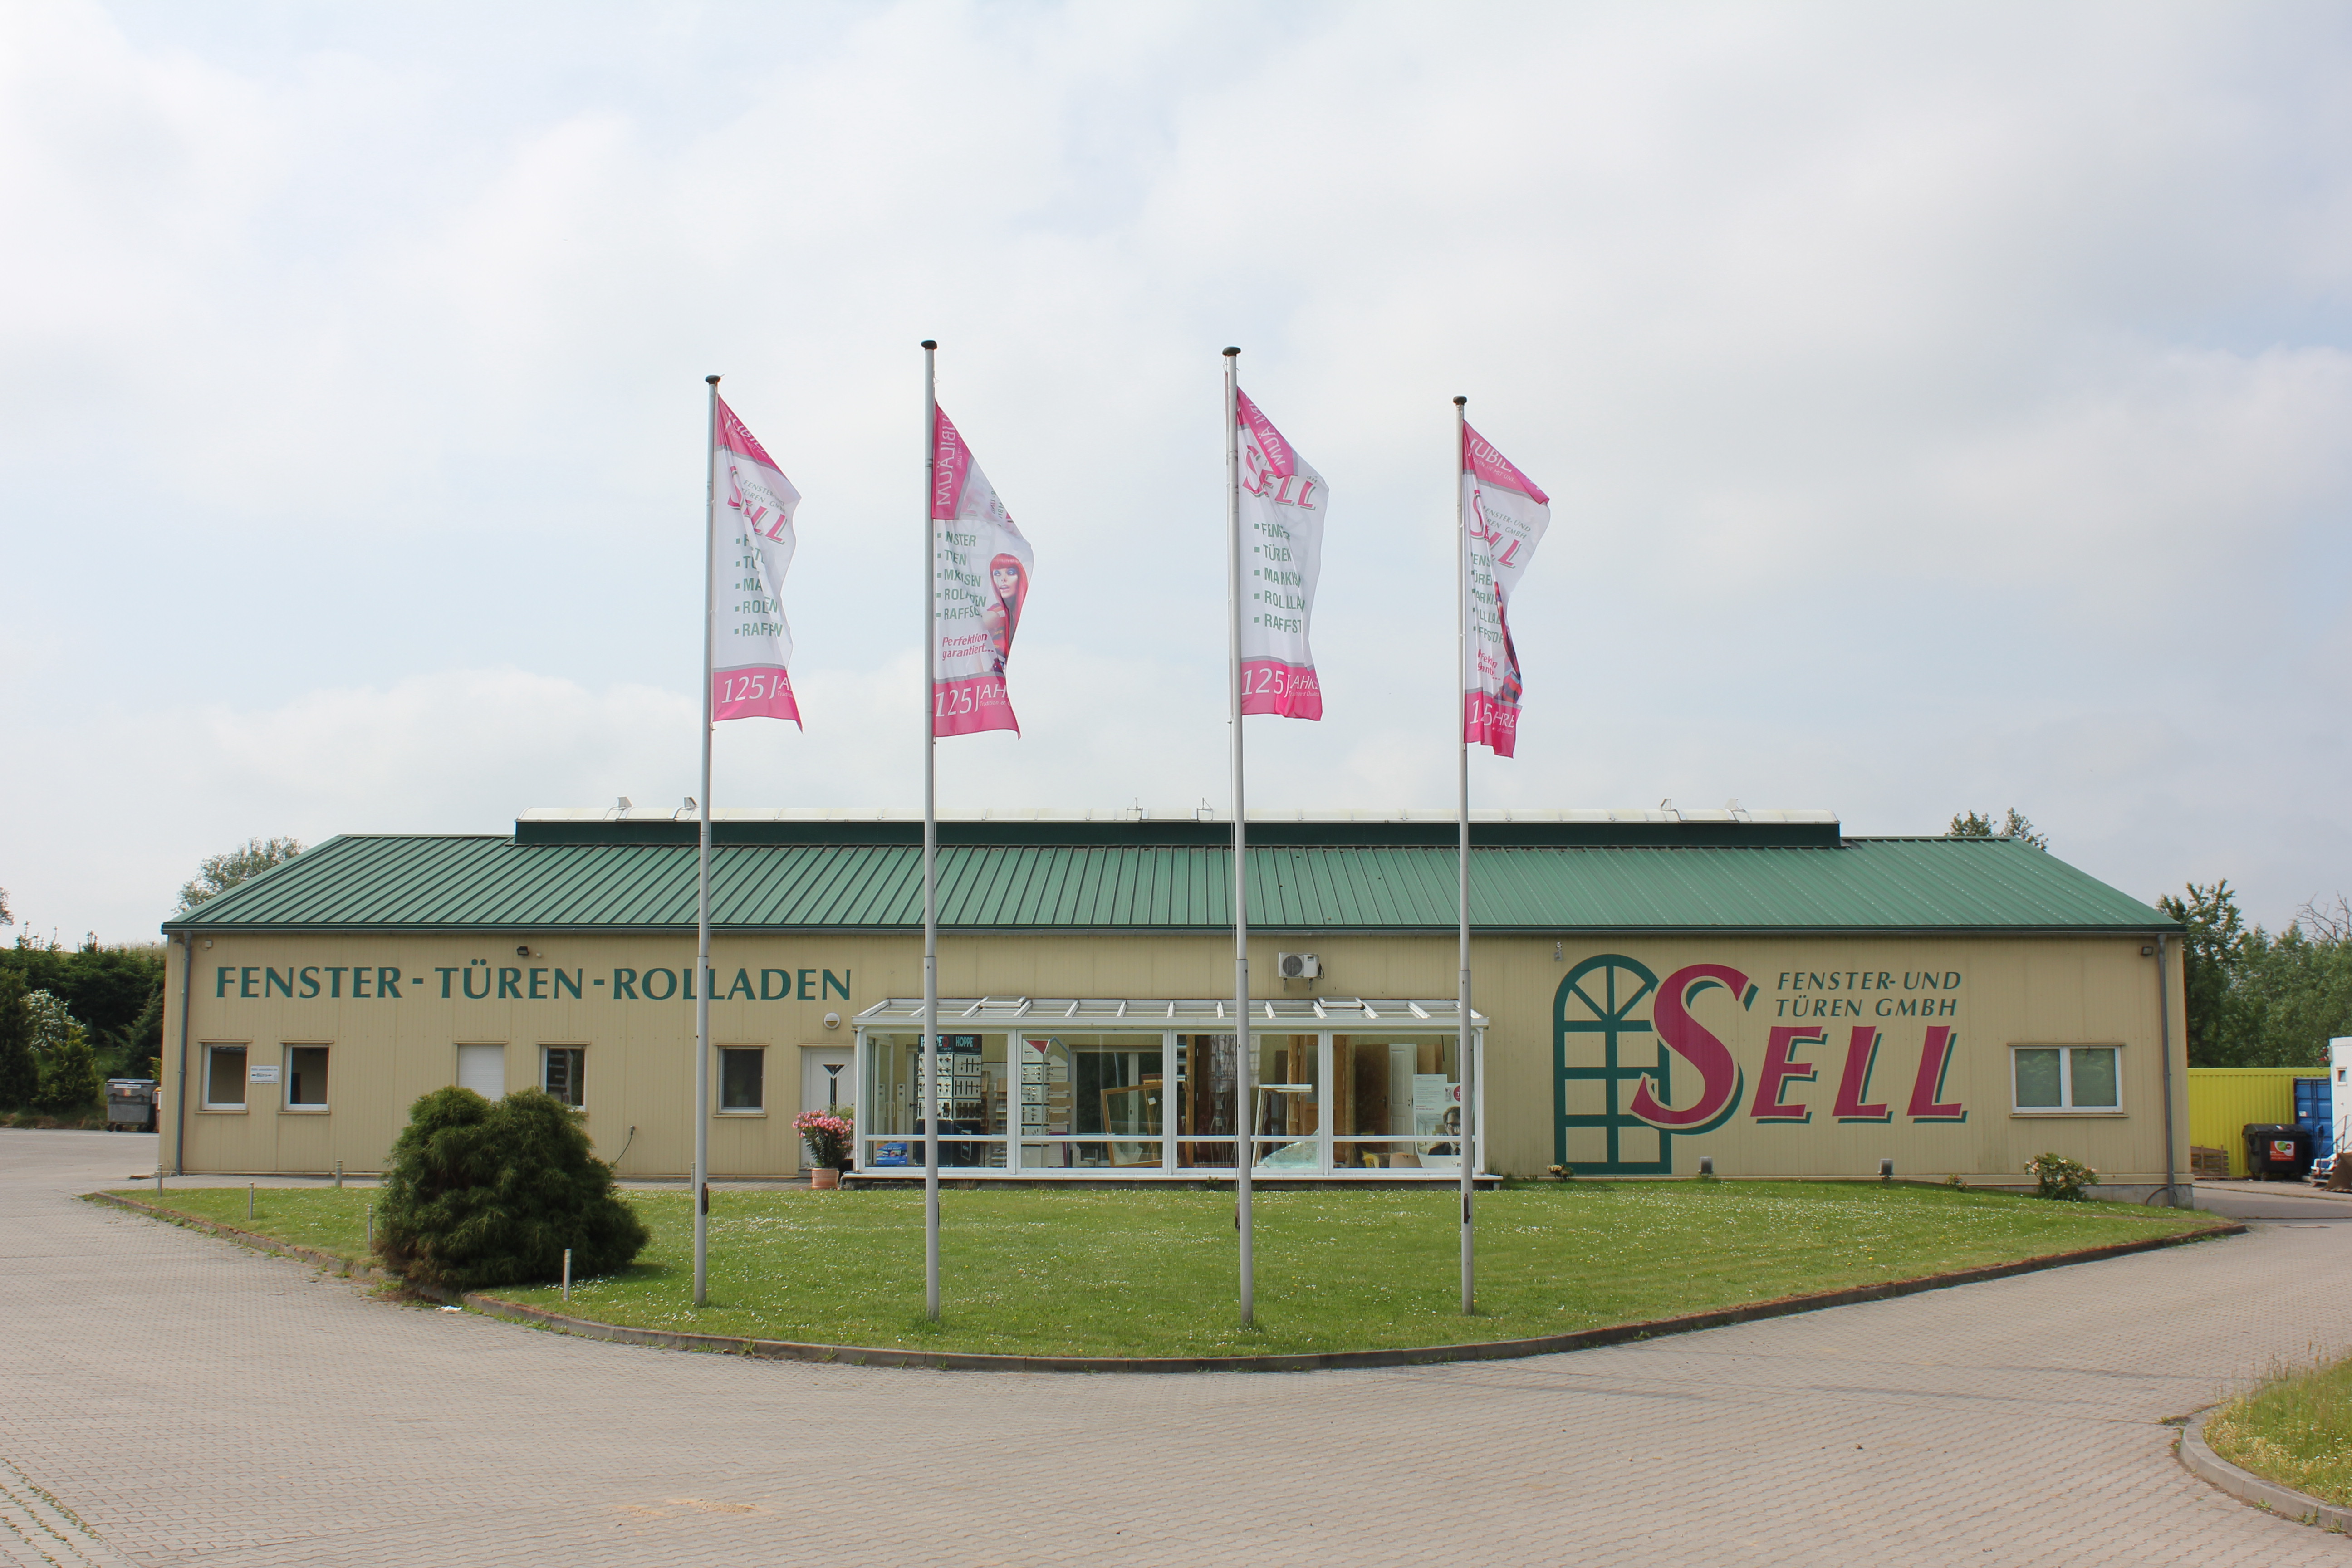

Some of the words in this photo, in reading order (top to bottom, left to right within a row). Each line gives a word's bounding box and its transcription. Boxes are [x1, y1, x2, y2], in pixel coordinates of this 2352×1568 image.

[1263, 544, 1292, 562] TÜREN
[942, 633, 988, 647] Perfektion
[721, 675, 765, 703] 125
[1241, 668, 1284, 696] 125
[936, 687, 972, 717] 125
[1775, 994, 1862, 1017] TÜREN
[1875, 998, 1957, 1017] GMBH
[956, 1036, 973, 1048] HOPPE
[1630, 963, 1968, 1135] SELL
